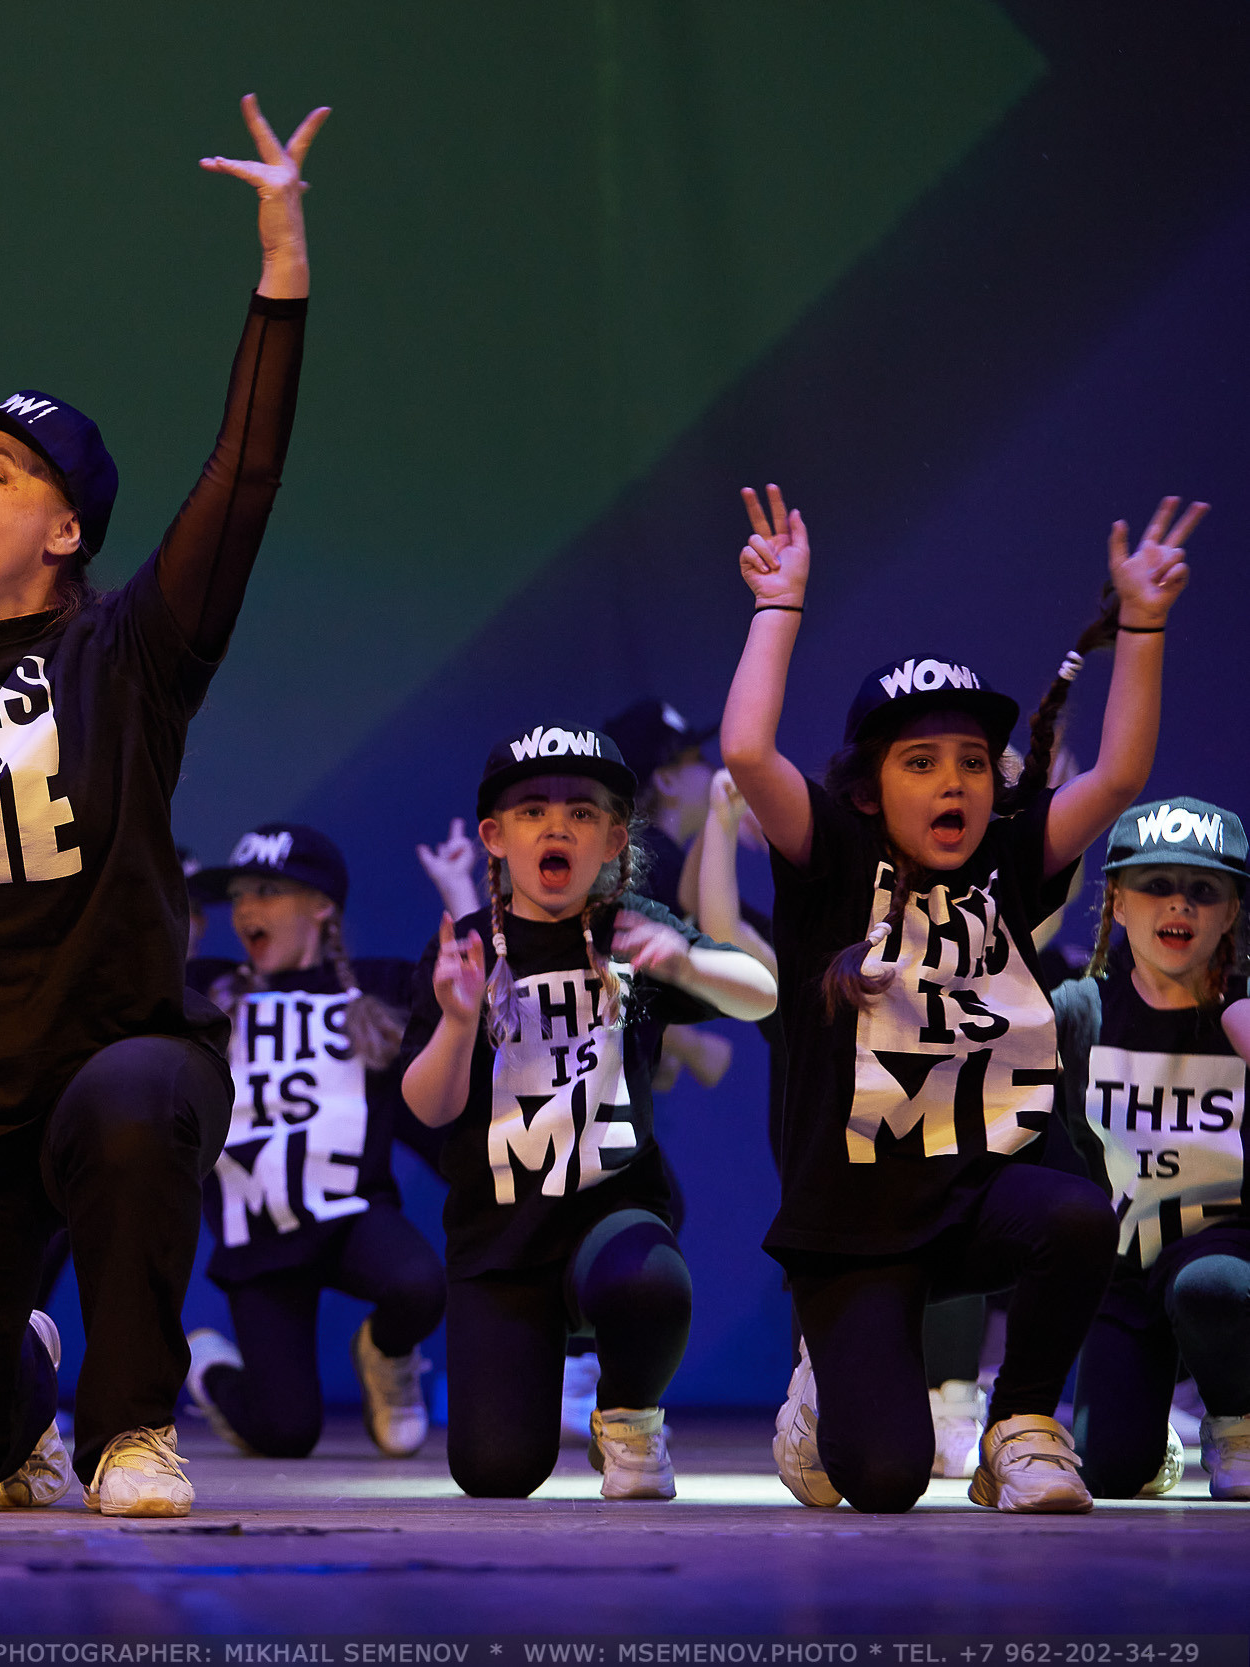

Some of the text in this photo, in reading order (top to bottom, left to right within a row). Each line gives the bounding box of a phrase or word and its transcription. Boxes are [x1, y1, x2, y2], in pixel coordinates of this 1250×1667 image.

[878, 658, 981, 699] WOW!
[1136, 803, 1224, 855] WOW!
[917, 977, 1011, 1044] IS
[550, 1037, 599, 1088] IS
[247, 1071, 320, 1126] IS
[845, 1049, 1057, 1164] ME
[1094, 1079, 1235, 1134] THIS
[487, 1080, 638, 1206] ME
[1136, 1148, 1181, 1180] IS
[213, 1130, 371, 1248] ME
